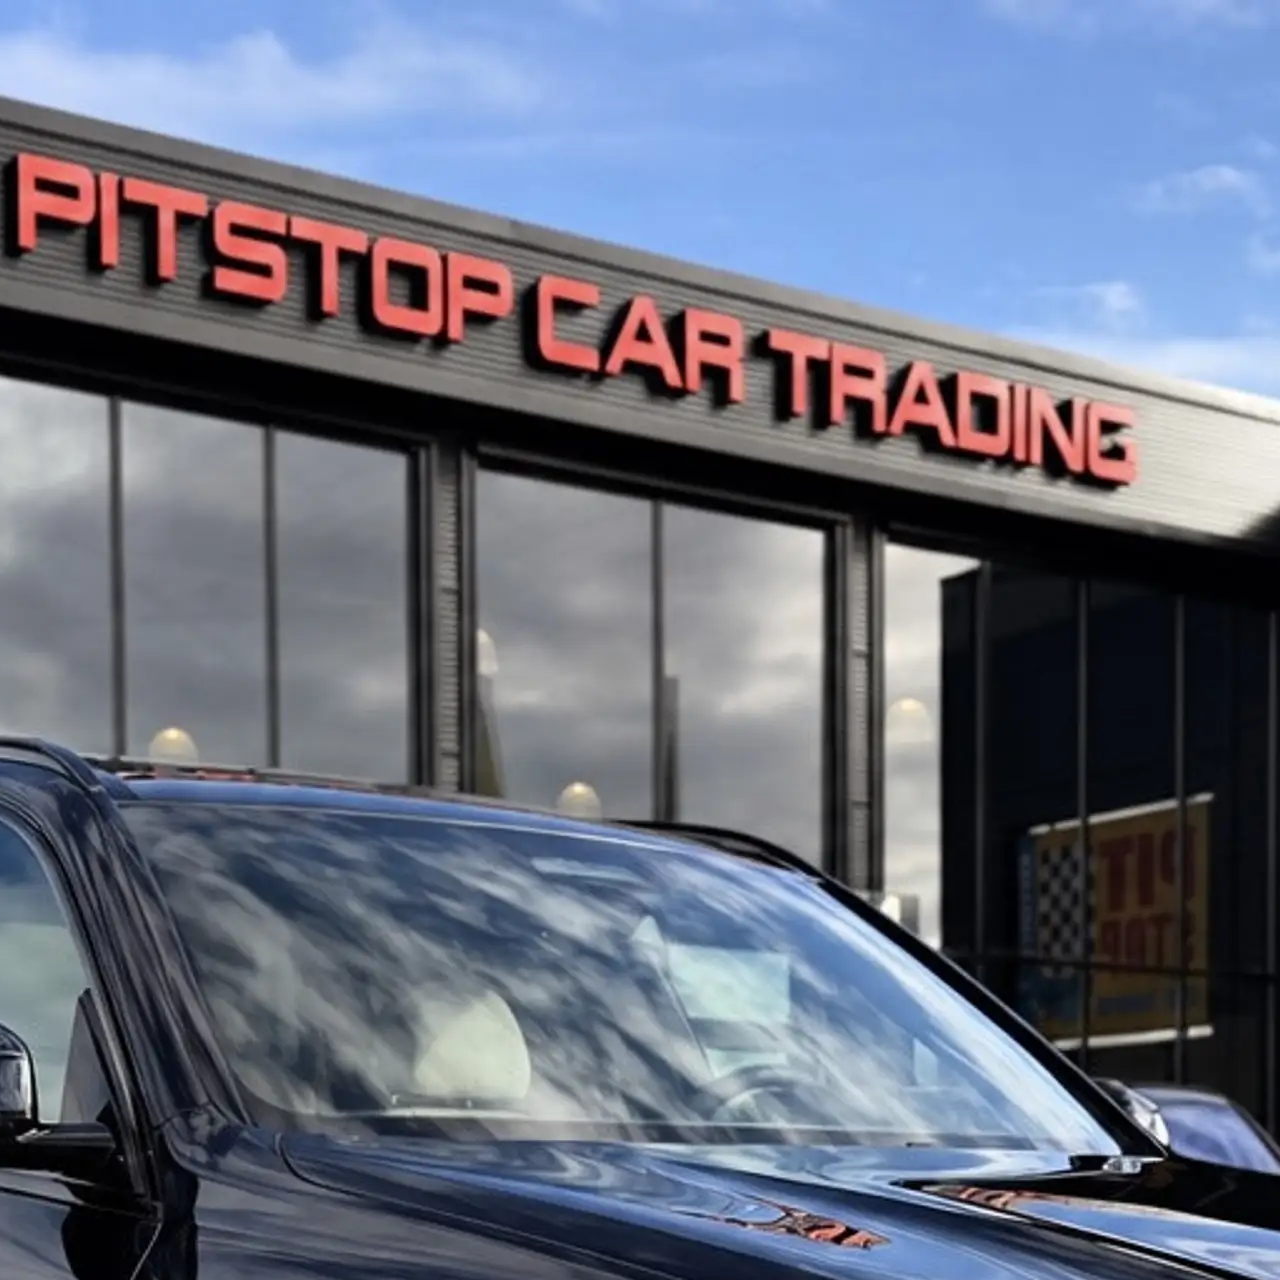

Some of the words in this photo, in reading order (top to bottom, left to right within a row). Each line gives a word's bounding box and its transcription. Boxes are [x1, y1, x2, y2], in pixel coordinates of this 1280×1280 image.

[18, 153, 514, 340] PITSTOP
[539, 276, 744, 401] CAR
[770, 329, 1136, 482] TRADING
